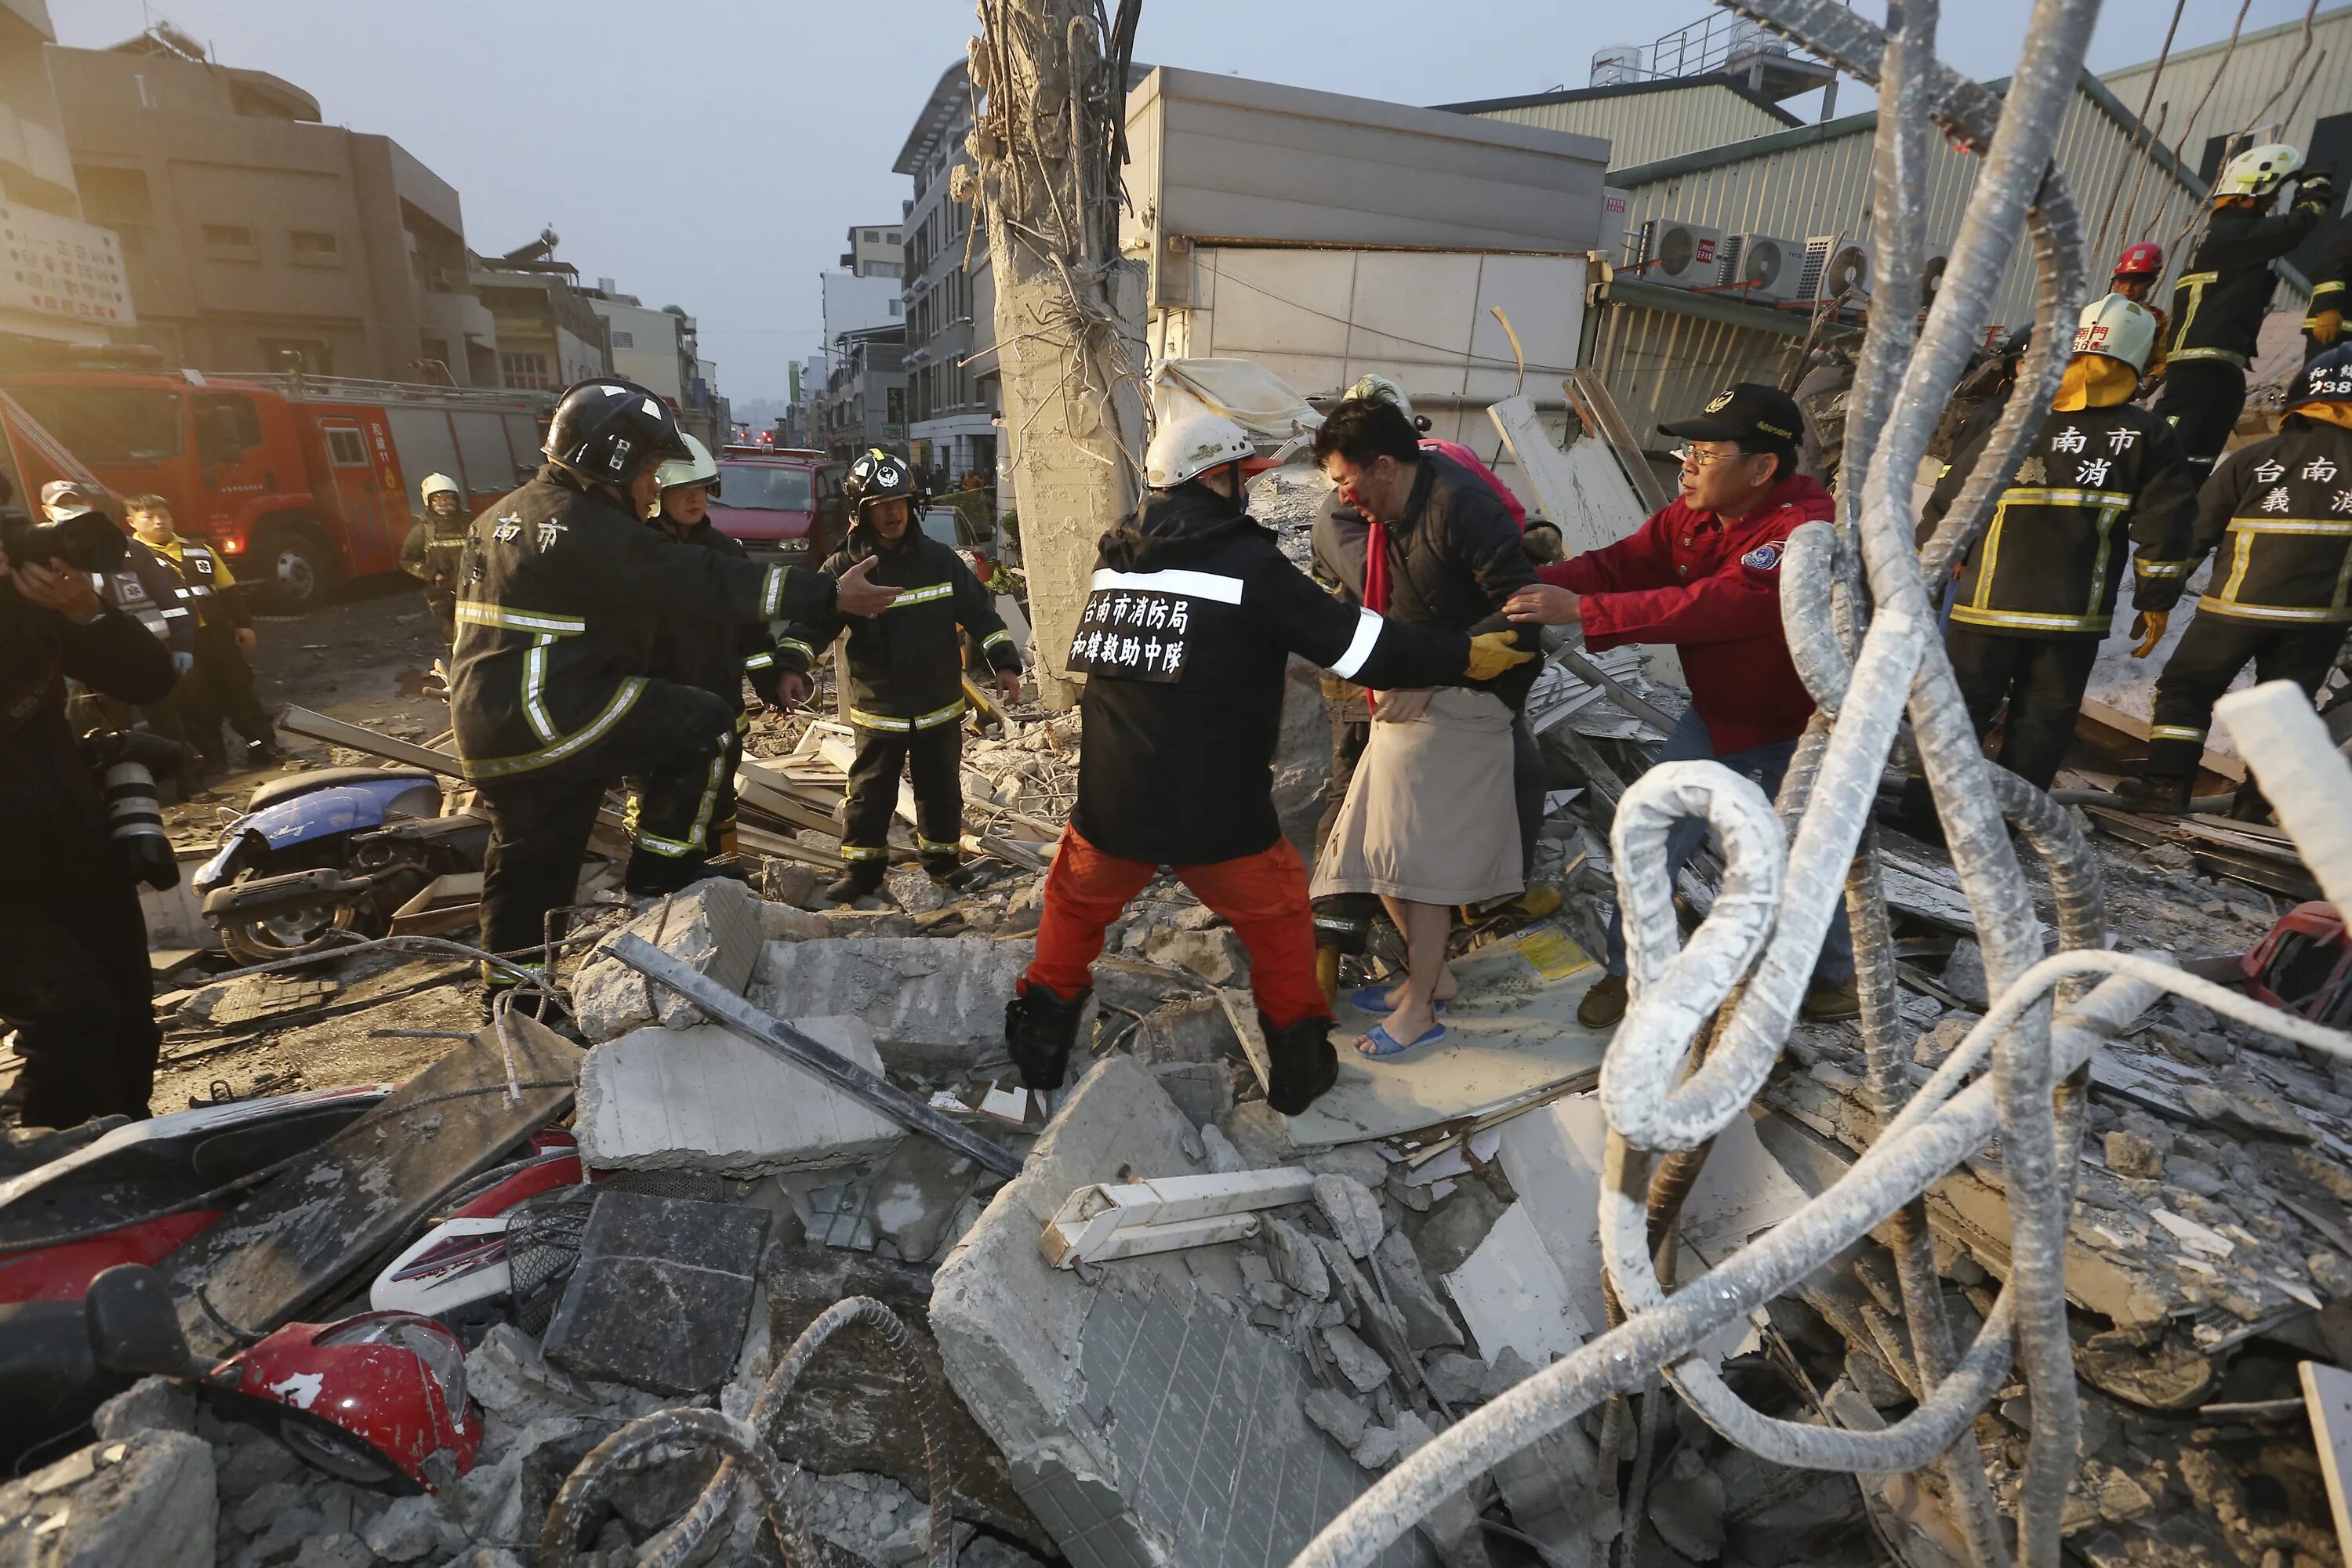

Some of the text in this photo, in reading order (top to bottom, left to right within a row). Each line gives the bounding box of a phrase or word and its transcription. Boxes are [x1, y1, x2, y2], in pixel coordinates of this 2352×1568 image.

[1788, 251, 1802, 260] TECO
[2074, 325, 2110, 341] 南門
[1083, 592, 1189, 635] 台南市消防局
[1069, 630, 1185, 675] 和緯救助中隊
